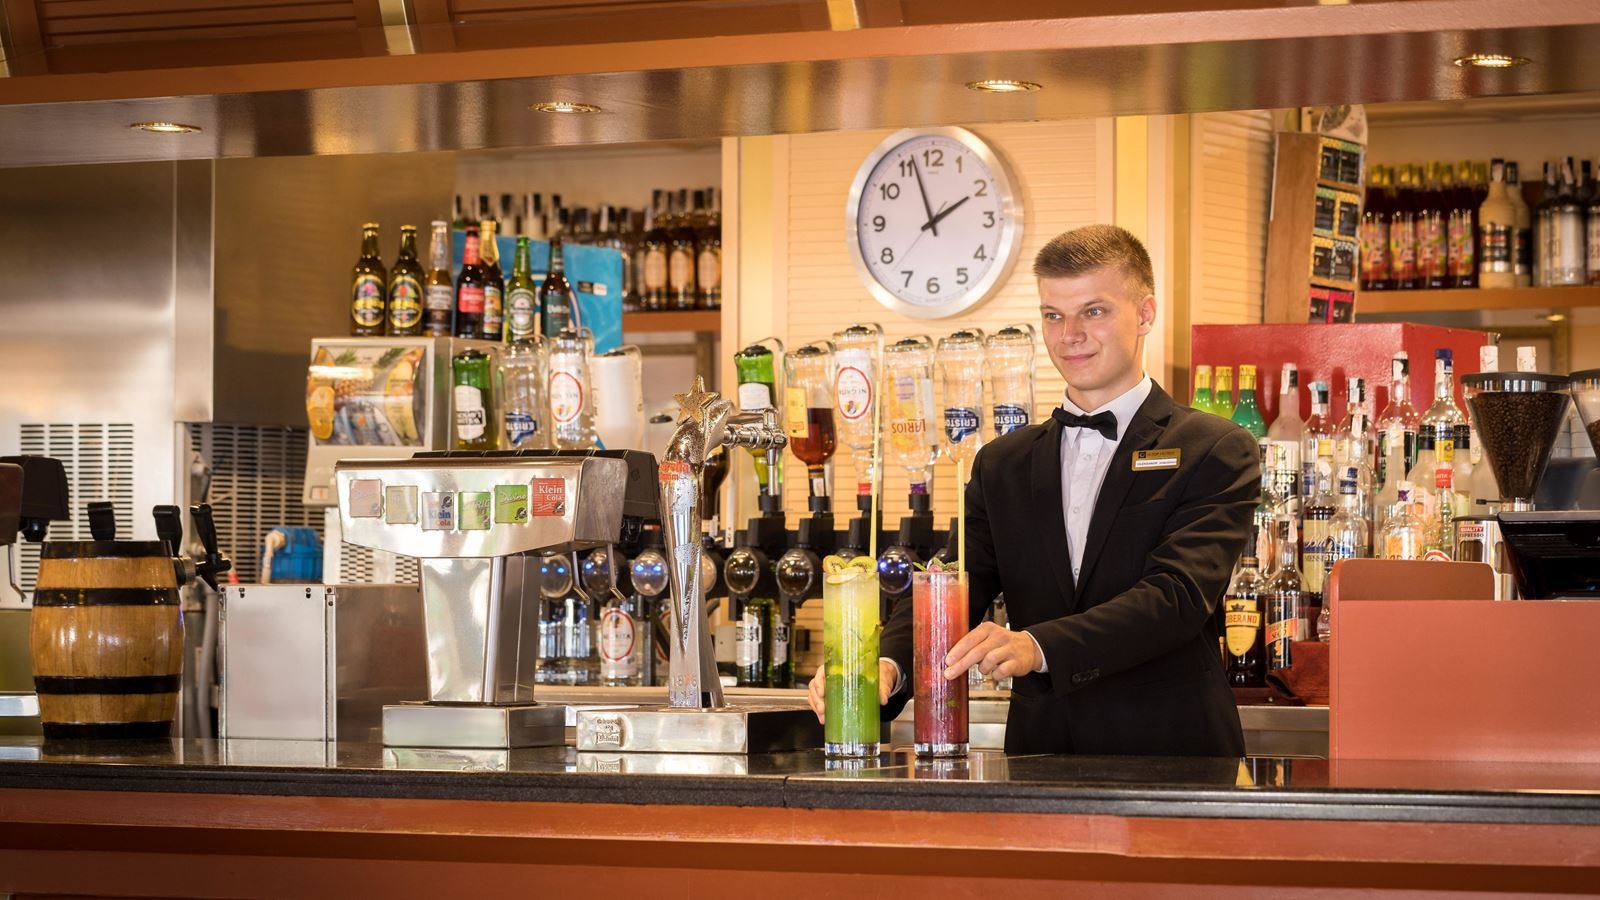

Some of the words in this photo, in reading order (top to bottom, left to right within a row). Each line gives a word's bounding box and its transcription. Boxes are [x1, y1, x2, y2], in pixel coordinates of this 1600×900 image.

[923, 150, 944, 167] 12
[955, 156, 963, 173] 1
[899, 159, 914, 177] 11
[880, 183, 900, 201] 10
[974, 179, 988, 197] 2
[872, 215, 886, 232] 9
[982, 211, 996, 229] 3
[880, 247, 894, 264] 8
[973, 244, 987, 262] 4
[900, 271, 914, 288] 7
[956, 267, 969, 285] 5
[926, 277, 940, 294] 6
[892, 418, 926, 434] LARIOS
[944, 418, 977, 427] ERISTO
[993, 414, 1026, 424] ERISTO
[538, 485, 562, 494] Klein
[1226, 613, 1258, 624] BERANO
